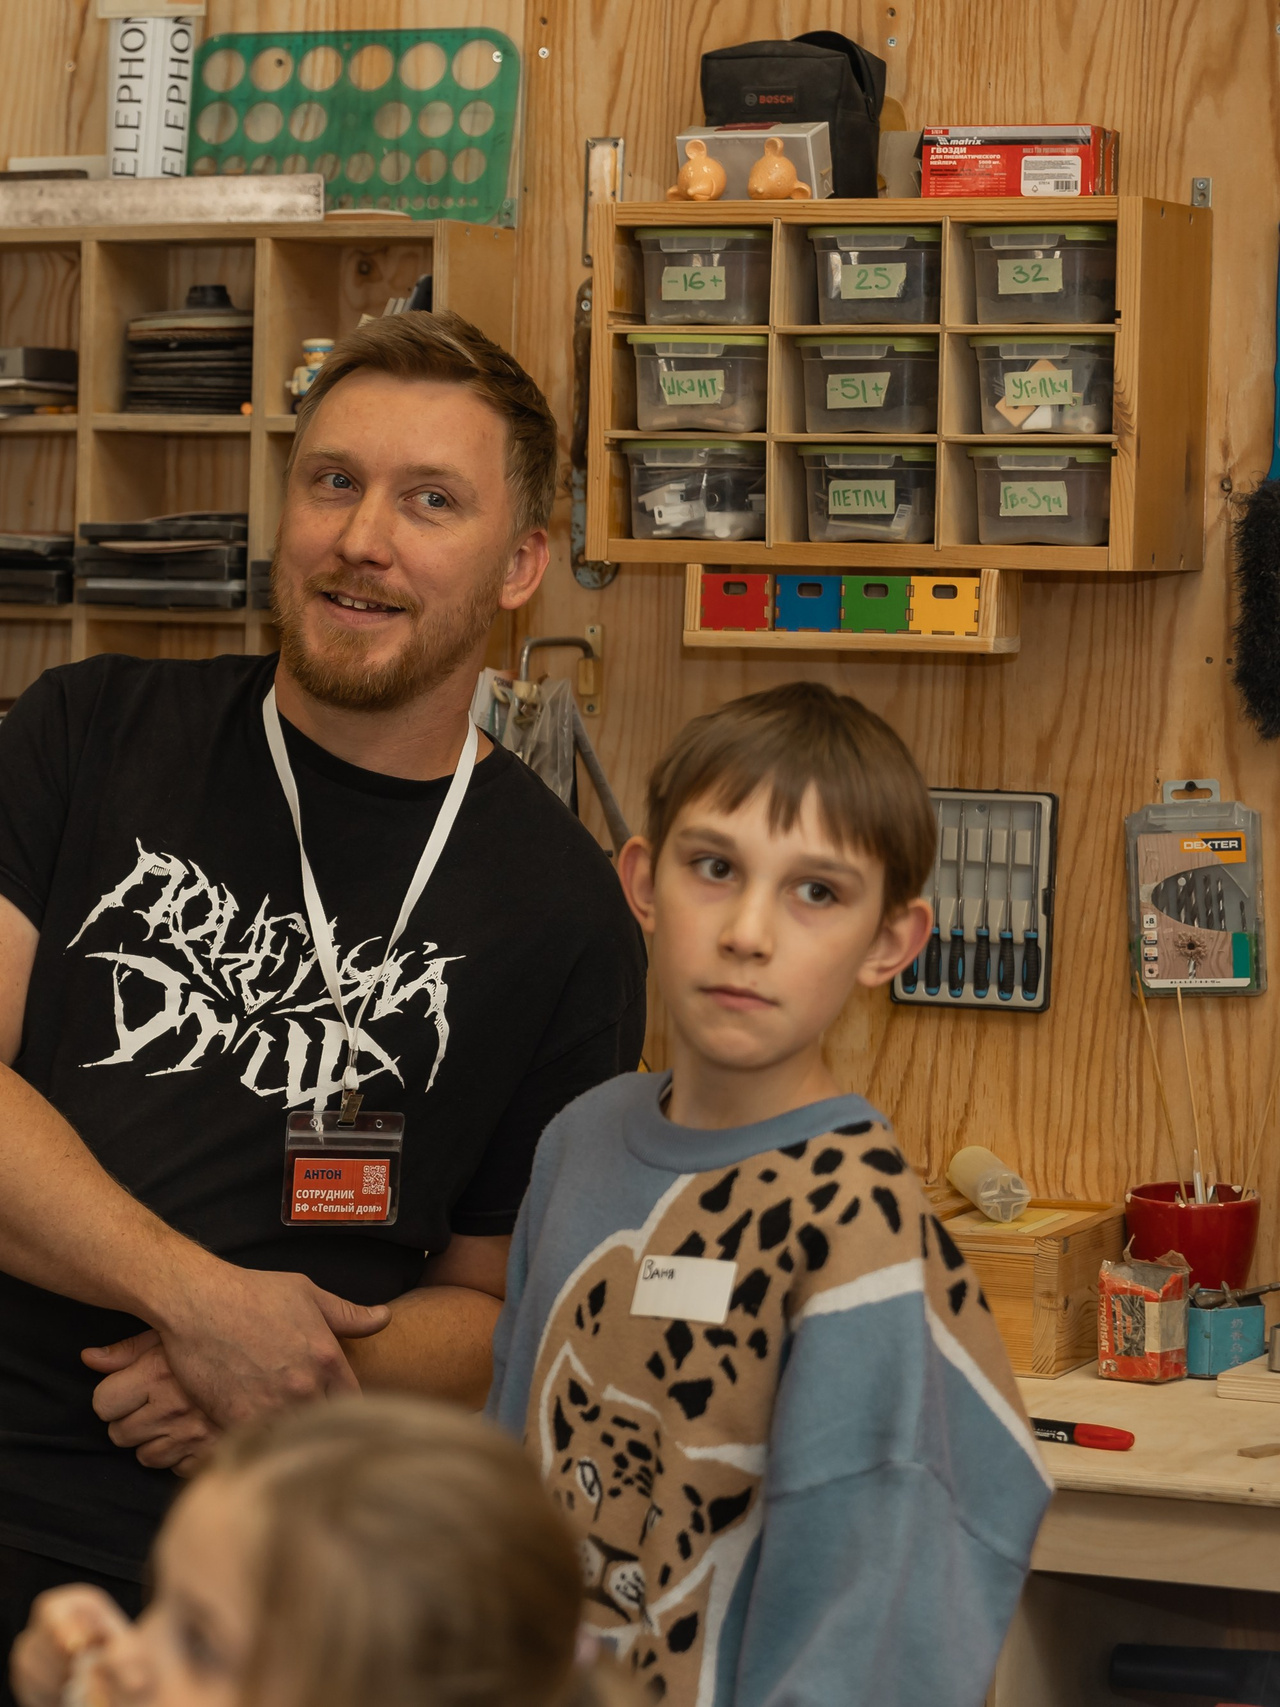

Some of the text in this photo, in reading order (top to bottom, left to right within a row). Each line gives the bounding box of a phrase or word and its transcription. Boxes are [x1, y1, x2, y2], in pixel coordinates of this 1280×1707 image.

[758, 94, 794, 105] BOSCH
[949, 136, 982, 146] matrix
[930, 147, 967, 155] ГВОЗДИ
[854, 267, 892, 291] 25
[1012, 263, 1050, 284] 32
[1183, 840, 1239, 850] DEXTER
[303, 1169, 342, 1180] АНТОН
[295, 1189, 355, 1201] СОТРУДНИК
[294, 1202, 383, 1215] БФ «Теплый дом»
